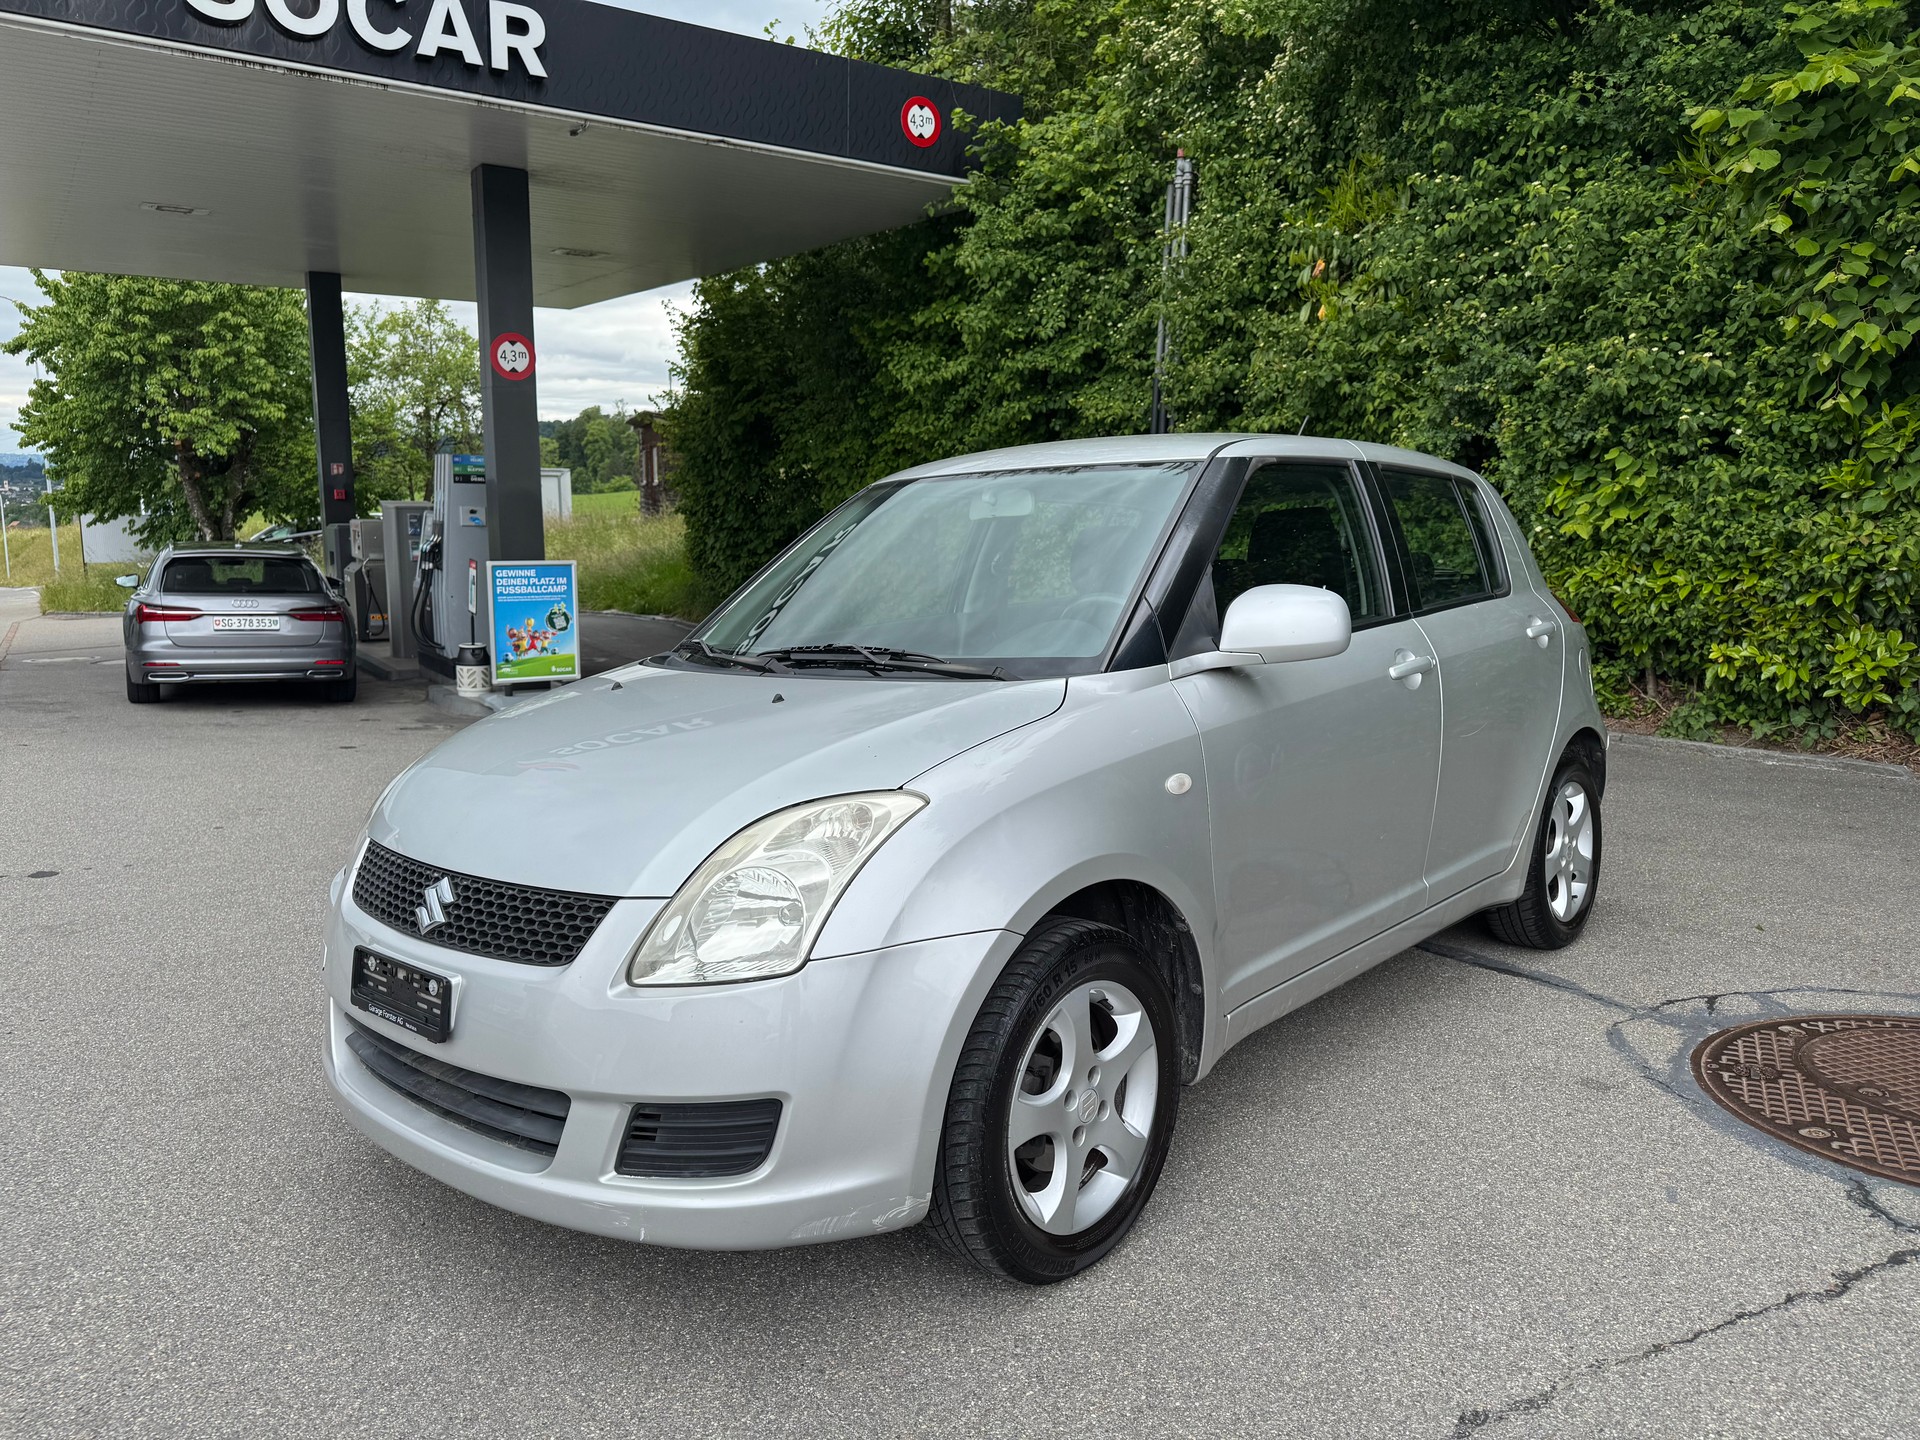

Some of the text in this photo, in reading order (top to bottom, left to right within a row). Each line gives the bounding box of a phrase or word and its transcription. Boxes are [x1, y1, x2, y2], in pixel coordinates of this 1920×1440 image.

[495, 569, 536, 577] GEWINNE
[496, 577, 567, 586] DEINEN PLATZ IM
[497, 585, 567, 594] FUSSBALLCAMP
[396, 1016, 404, 1025] AG
